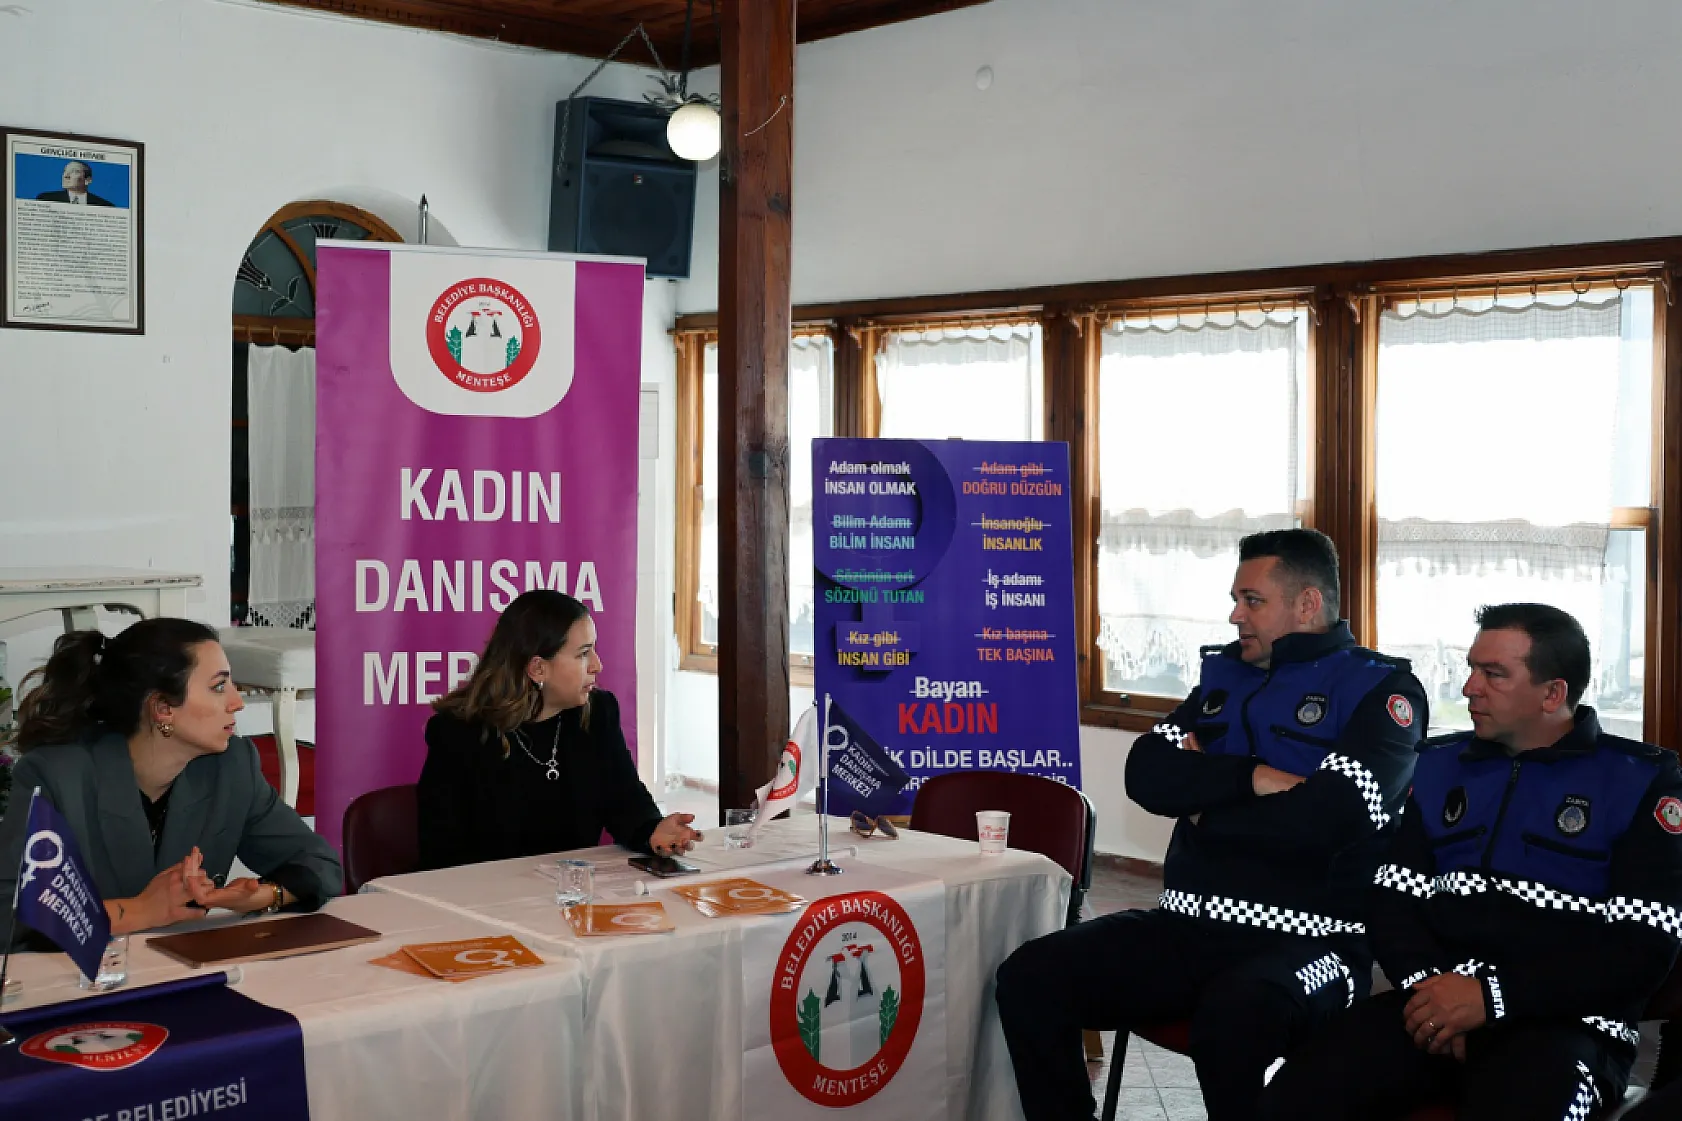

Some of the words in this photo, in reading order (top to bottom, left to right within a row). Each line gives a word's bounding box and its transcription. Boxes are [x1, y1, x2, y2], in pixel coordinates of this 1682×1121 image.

[829, 460, 867, 475] Adam
[870, 460, 911, 475] olmak
[980, 461, 1017, 475] Adam
[1021, 461, 1044, 478] gibi
[400, 467, 562, 524] KADIN
[824, 477, 866, 495] İNSAN
[869, 480, 917, 496] OLMAK
[962, 479, 1008, 495] DOĞRU
[1010, 479, 1062, 496] DÜZGÜN
[833, 514, 866, 529] Bilim
[869, 514, 912, 529] Adamı
[981, 512, 1044, 534] İnsanoğlu
[829, 532, 867, 549] BİLİM
[870, 532, 915, 550] İNSANI
[983, 533, 1044, 551] İNSANLIK
[836, 568, 893, 583] Sözünün
[895, 568, 914, 583] eri
[987, 568, 1000, 589] İş
[1003, 571, 1043, 586] adamı
[825, 586, 879, 604] SÖZÜNÜ
[882, 589, 925, 604] TUTAN
[985, 589, 999, 611] İŞ
[1001, 589, 1046, 607] İNSANI
[849, 630, 870, 645] Kız
[872, 630, 899, 648] gibi
[982, 626, 1004, 641] Kız
[1005, 626, 1048, 645] başına
[837, 648, 880, 666] İNSAN
[882, 648, 910, 666] GİBİ
[976, 647, 1003, 662] TEK
[1005, 647, 1056, 666] BAŞINA
[914, 675, 984, 703] Bayan
[898, 702, 999, 735] KADIN
[909, 745, 974, 769] DİLDE
[977, 749, 1074, 772] BAŞLAR..
[780, 903, 839, 990] BELEDİYE
[839, 897, 916, 965] BAŞKANLIĞI
[1486, 975, 1506, 1019] ZABITA
[811, 1057, 890, 1096] MENTEŞE
